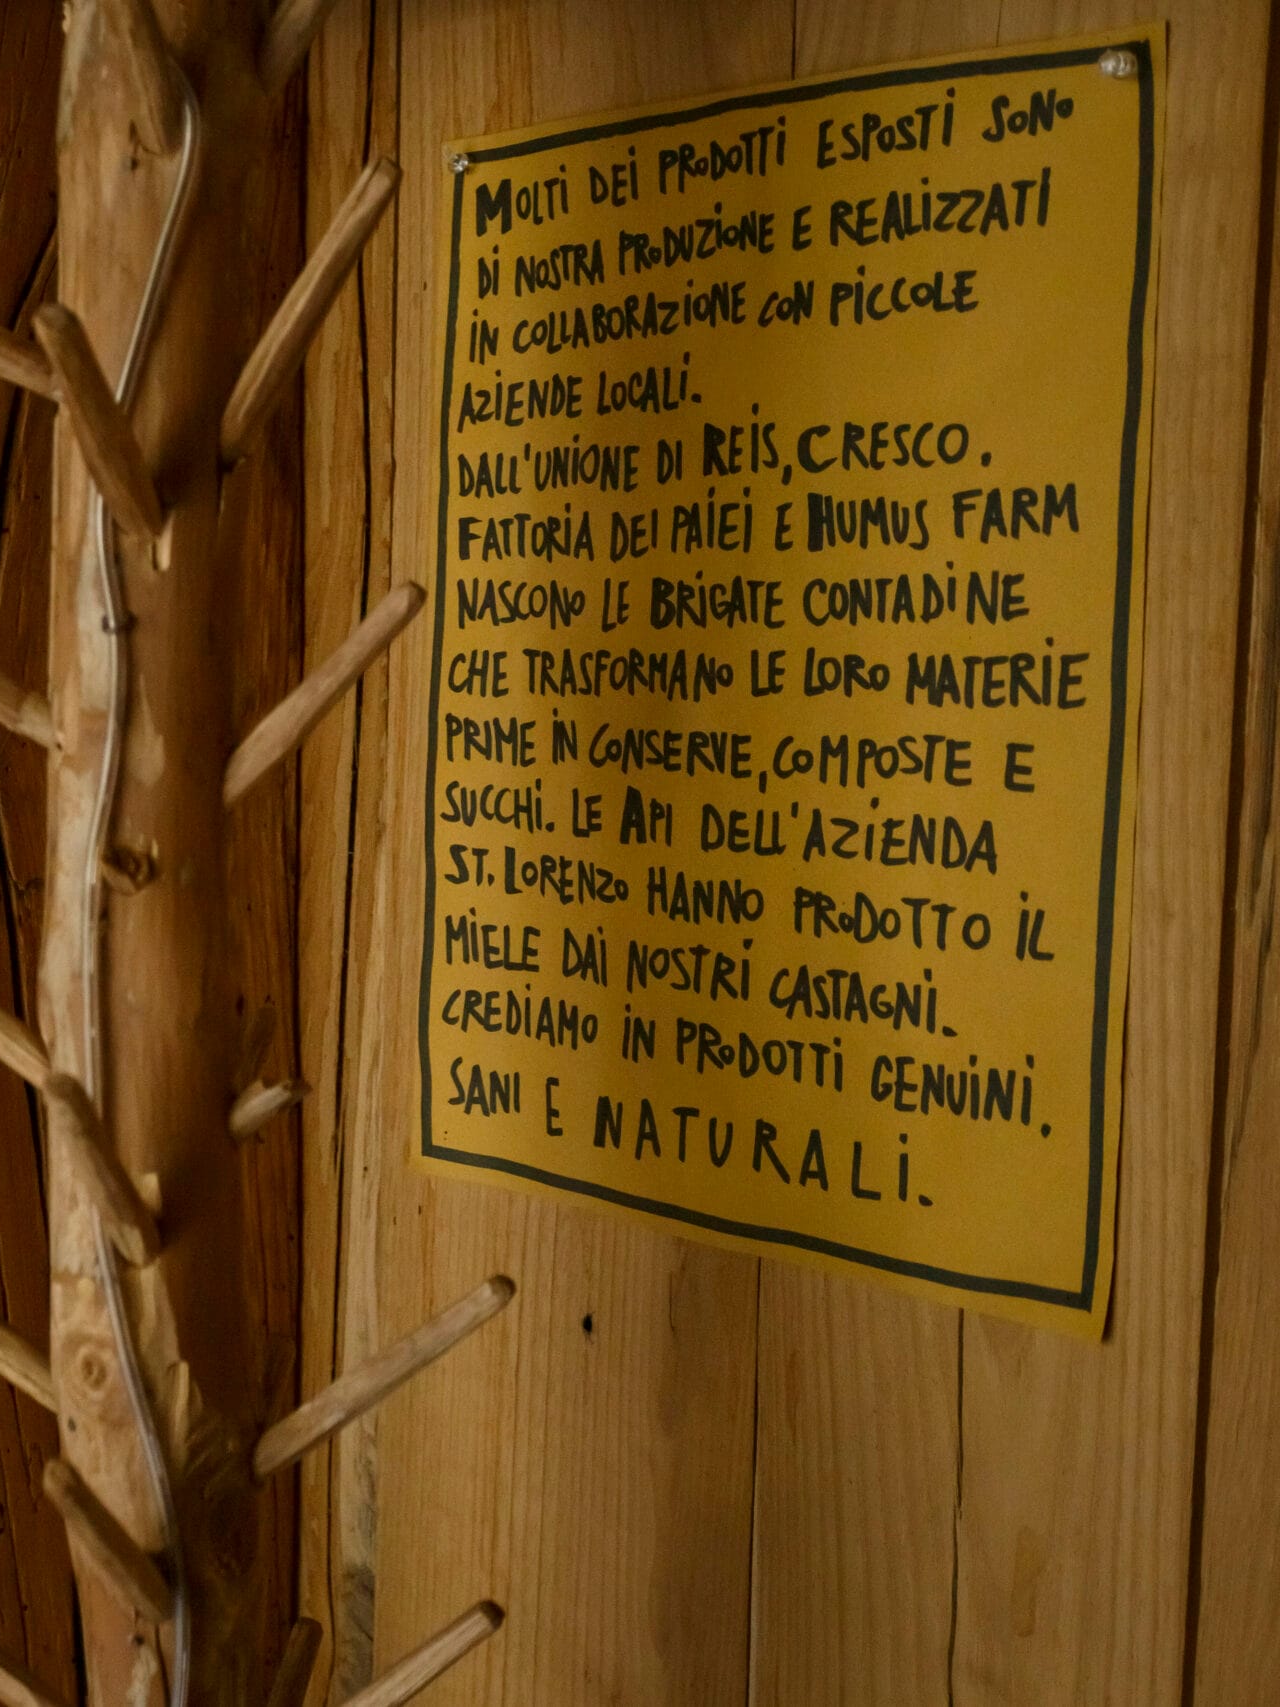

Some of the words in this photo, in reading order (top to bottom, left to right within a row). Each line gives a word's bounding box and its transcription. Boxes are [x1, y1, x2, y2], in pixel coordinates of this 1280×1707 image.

[476, 164, 568, 237] MOLTI
[589, 146, 638, 207] DEI
[659, 116, 785, 194] PRODOTTI
[817, 87, 955, 169] ESPOSTI
[982, 89, 1073, 142] SONO
[478, 245, 499, 299] DI
[515, 240, 604, 297] NOSTRA
[619, 202, 774, 275] PRODUZIONE
[792, 206, 812, 251] E
[830, 167, 1051, 246] REALIZZATI
[470, 309, 498, 365] IN
[513, 279, 745, 354] COLLABORAZIONE
[758, 280, 814, 327] CON
[830, 265, 978, 326] PICCOLE
[458, 370, 582, 433] AZIENDE
[597, 352, 701, 415] LOCALI.
[458, 434, 640, 498] DALL'UNIONE
[657, 439, 682, 484] DI
[459, 503, 594, 563] FATTORIA
[610, 509, 658, 563] DEI
[671, 487, 752, 554] PAIEI
[775, 503, 793, 551] E
[807, 493, 929, 552] HUMUS
[953, 483, 1079, 543] FARM
[457, 578, 585, 630] NASCONO
[602, 578, 629, 632] LE
[650, 571, 784, 629] BRIGATE
[803, 561, 1029, 626] CONTADINE
[448, 650, 508, 698] CHE
[523, 648, 733, 702] TRASFORMANO
[751, 650, 785, 697] LE
[804, 647, 890, 697] LORO
[906, 637, 1089, 709] MATERIE
[445, 713, 536, 767] PRIME
[552, 708, 577, 765] IN
[1005, 743, 1034, 792] E
[440, 778, 554, 833] SUCCHI.
[572, 788, 602, 838] LE
[620, 786, 672, 846] API
[701, 797, 997, 874] DELL'AZIENDA
[445, 844, 494, 886] ST.
[505, 846, 628, 905] LORENZO
[647, 867, 764, 924] HANNO
[794, 886, 990, 951] PRODOTTO
[1016, 891, 1054, 961] IL
[445, 908, 540, 972] MIELE
[562, 927, 607, 987] DAI
[627, 939, 753, 1001] NOSTRI
[769, 965, 957, 1037] CASTAGNI.
[442, 984, 598, 1050] CREDIAMO
[622, 1004, 655, 1063] IN
[677, 1017, 843, 1092] PRODOTTI
[871, 1055, 1051, 1138] GENUINI.
[448, 1057, 520, 1117] SANI
[546, 1077, 563, 1136] E
[593, 1096, 933, 1206] NATURALI.
